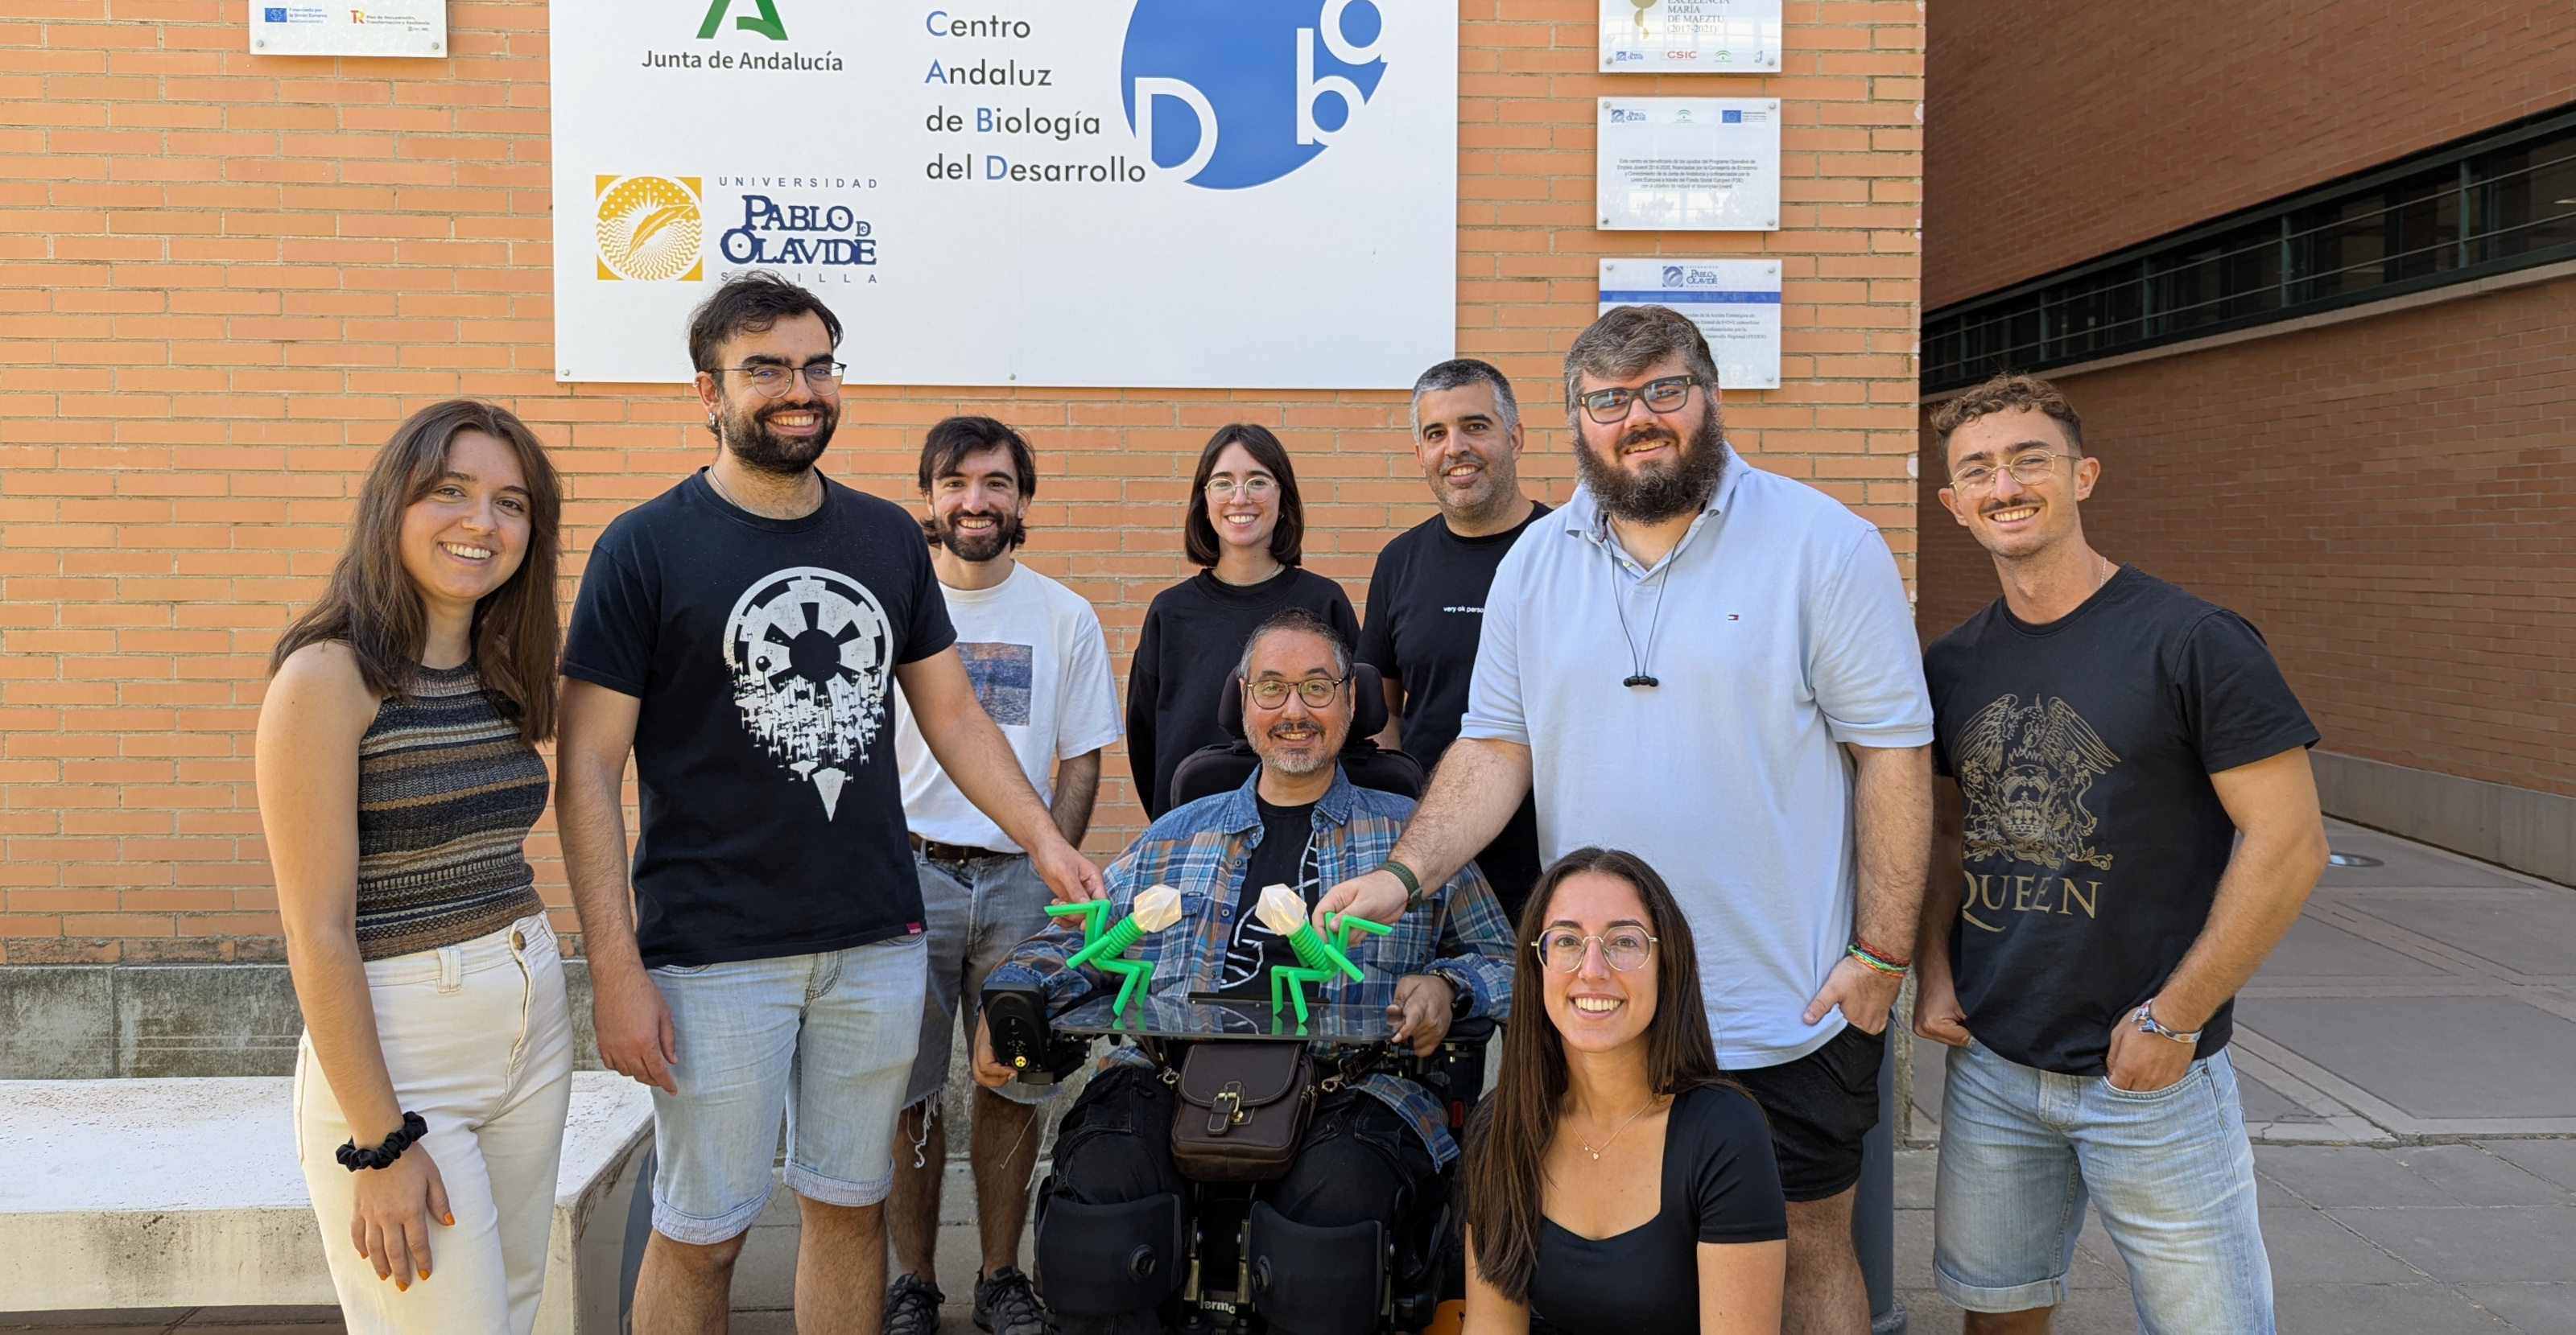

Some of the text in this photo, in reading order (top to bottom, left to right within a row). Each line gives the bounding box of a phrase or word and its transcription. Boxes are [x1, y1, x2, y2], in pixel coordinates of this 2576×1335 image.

[1667, 4, 1700, 14] MARÍA
[926, 10, 1031, 39] Centro
[1667, 15, 1724, 23] DE MAEZTU
[1666, 24, 1717, 34] (2017-2021)
[642, 50, 844, 71] Junta de Andalucía
[1666, 51, 1697, 59] CSIC
[925, 59, 1052, 87] Andaluz
[926, 105, 1100, 141] de Biología
[926, 153, 1146, 183] del Desarrollo
[720, 177, 877, 188] UNIVERSIDAD
[741, 195, 853, 232] PABLO
[720, 228, 877, 265] OLAVIDE
[720, 272, 877, 283] SVILLA
[1204, 1300, 1236, 1314] ermo
